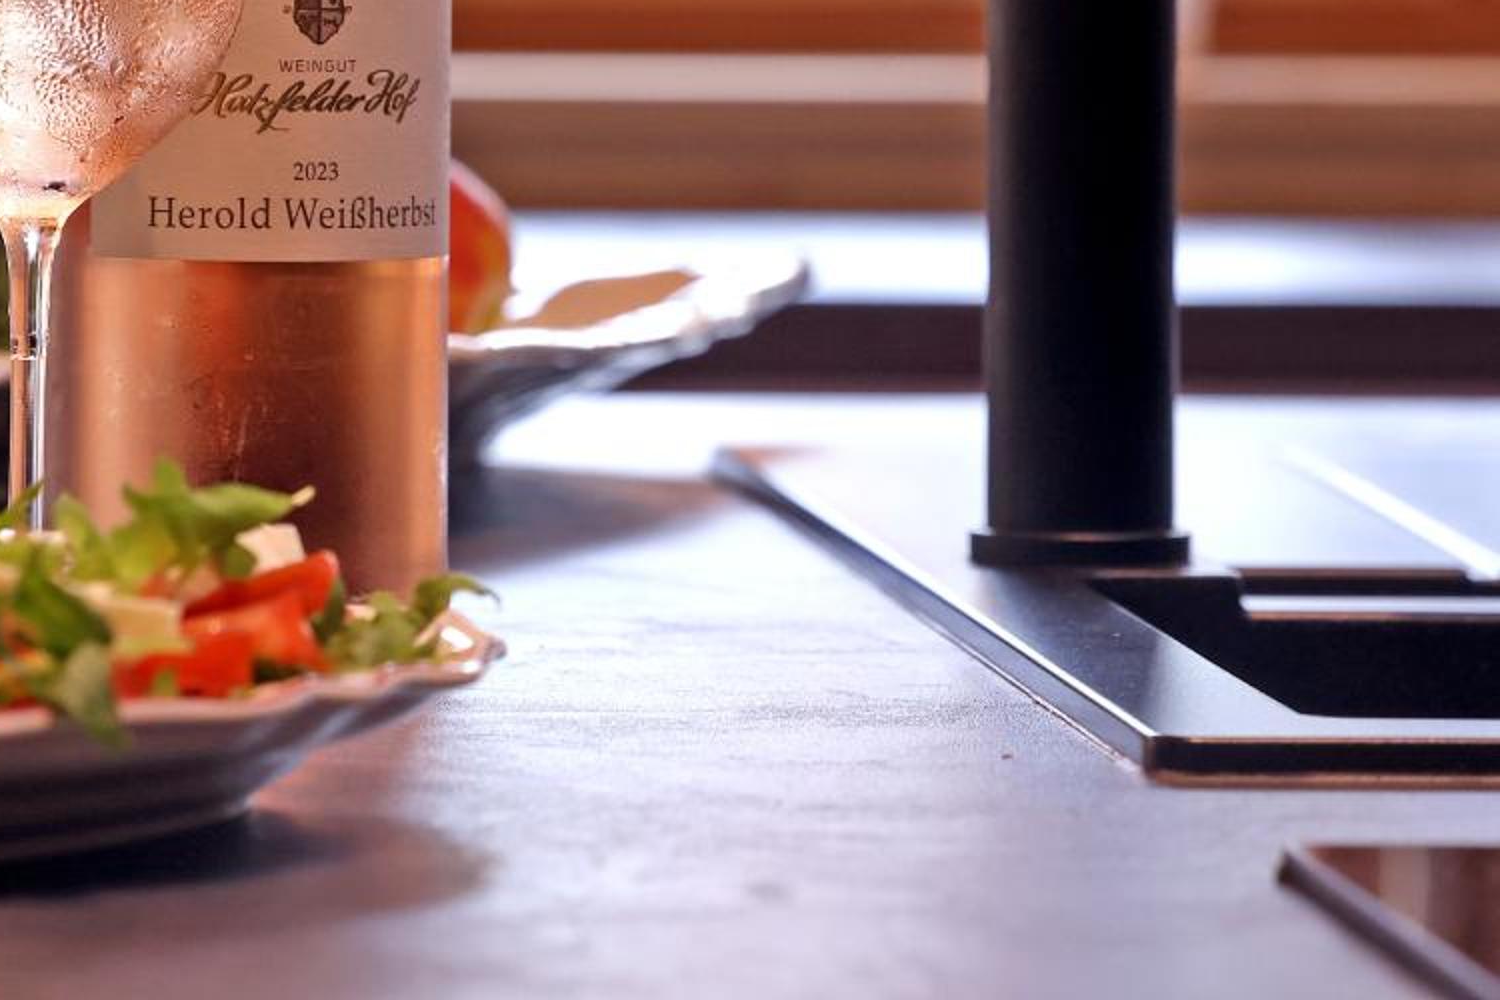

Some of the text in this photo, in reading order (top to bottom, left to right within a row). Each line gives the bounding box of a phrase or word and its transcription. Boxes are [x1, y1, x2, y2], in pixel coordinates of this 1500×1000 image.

[278, 58, 357, 73] WEINGUT
[363, 69, 421, 124] Hof
[292, 162, 339, 181] 2023
[148, 195, 436, 229] Herold Weißherbst
